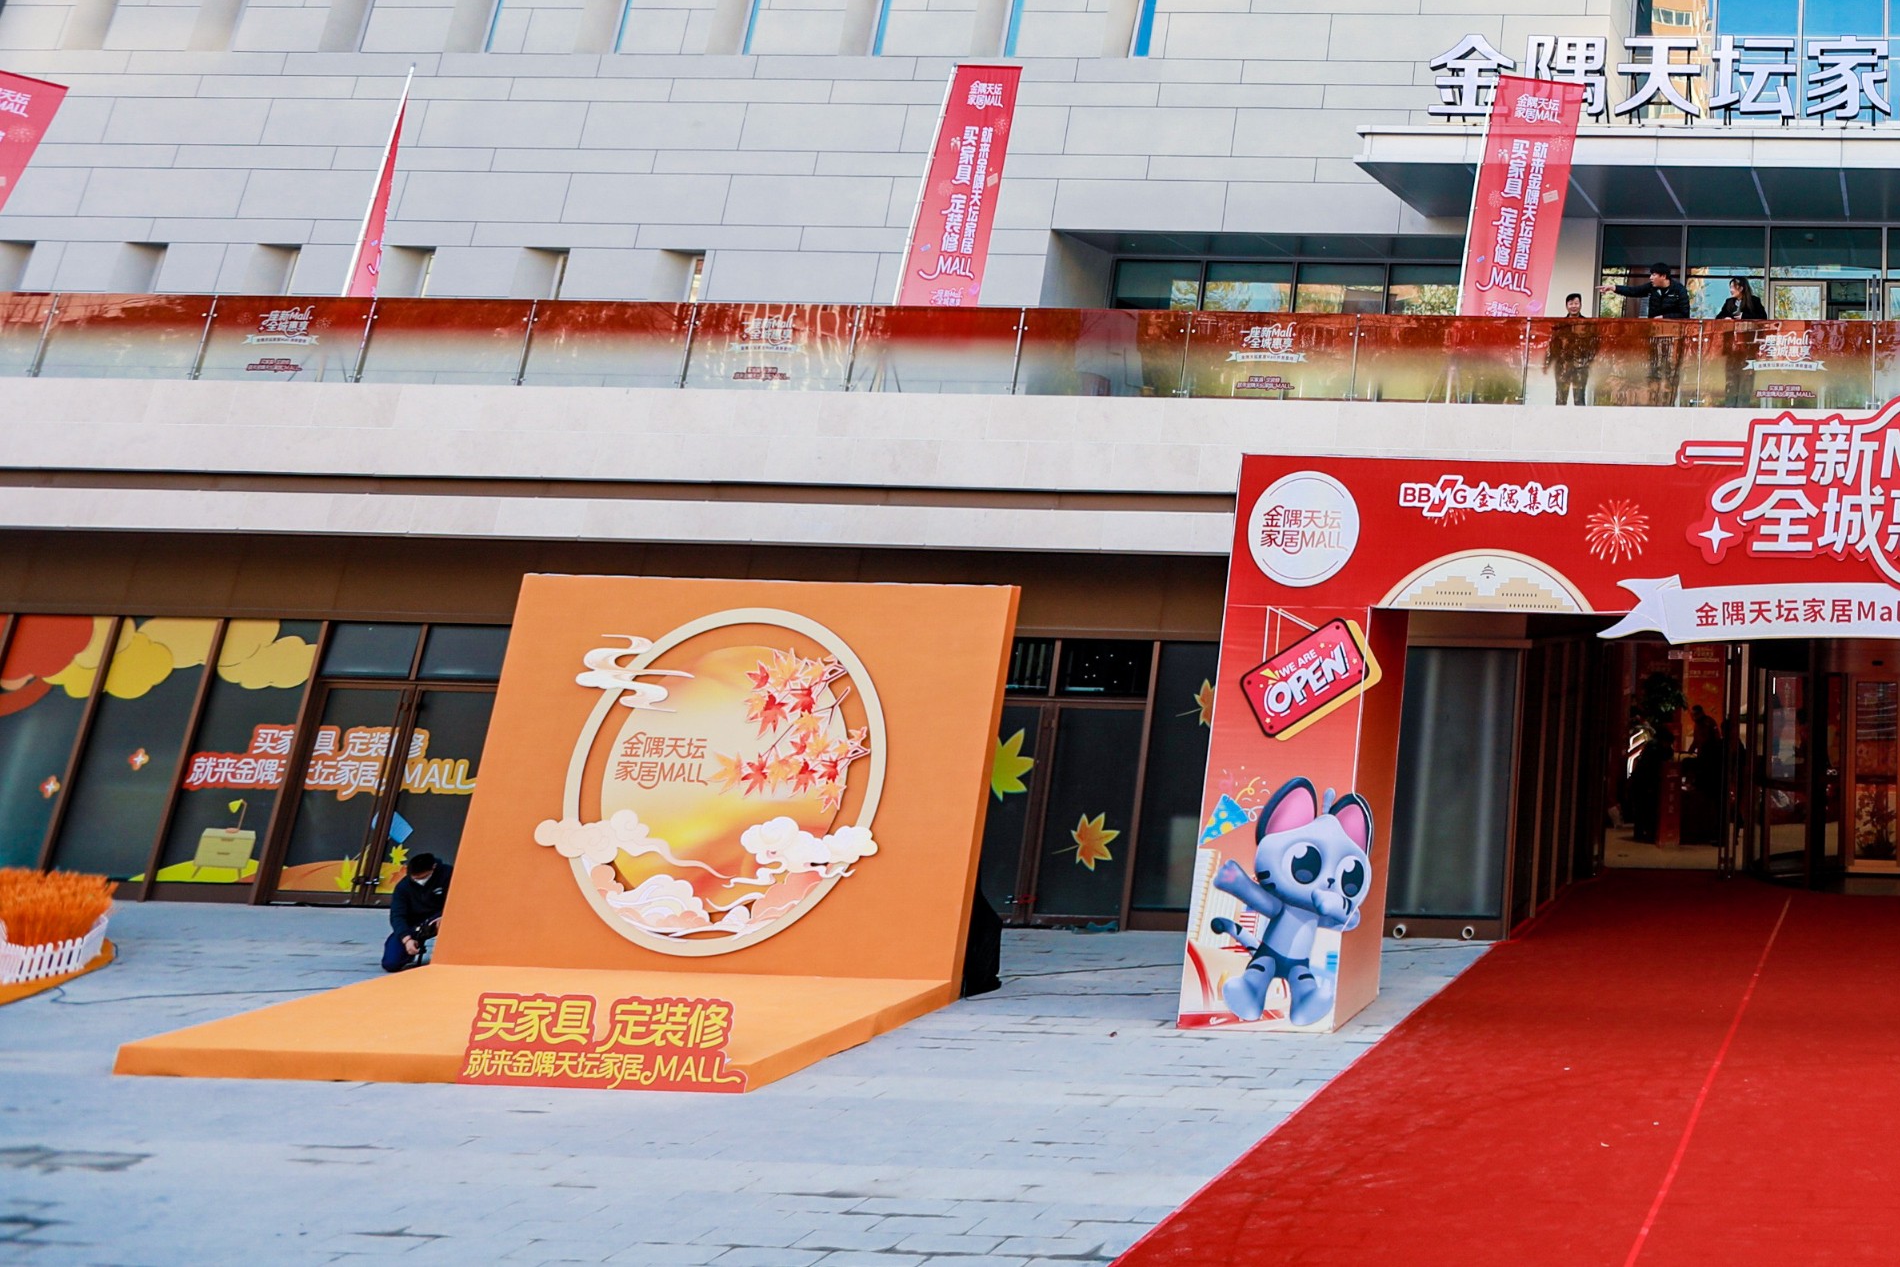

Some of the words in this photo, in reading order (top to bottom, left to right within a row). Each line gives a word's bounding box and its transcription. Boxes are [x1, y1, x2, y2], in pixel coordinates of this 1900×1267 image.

[969, 80, 1003, 95] 金隅天坛
[1516, 94, 1560, 111] 金隅天坛
[1514, 107, 1561, 124] 家居MALL
[951, 125, 979, 184] 买家具
[1501, 139, 1530, 200] 买家具
[960, 126, 994, 255] 就来金隅天坛家居
[1513, 141, 1548, 271] 就来金隅天坛家居
[941, 194, 967, 252] 定装修
[1492, 207, 1519, 266] 定装修
[918, 255, 975, 279] MALL
[1475, 266, 1532, 296] MALL
[1240, 322, 1297, 341] 一座新Mall
[1402, 481, 1468, 510] BBMG
[1473, 481, 1566, 513] 金隅集团
[1263, 505, 1342, 529] 金隅天坛
[1259, 529, 1348, 555] 家居MALL
[1278, 662, 1297, 679] WE
[1298, 648, 1318, 668] ARE
[620, 731, 708, 760] 金隅天坛
[614, 760, 709, 790] 家居MALL
[474, 997, 593, 1045] 买家具
[595, 1001, 729, 1054] 定装修
[463, 1049, 742, 1090] 就来金隅天坛家居MALL
